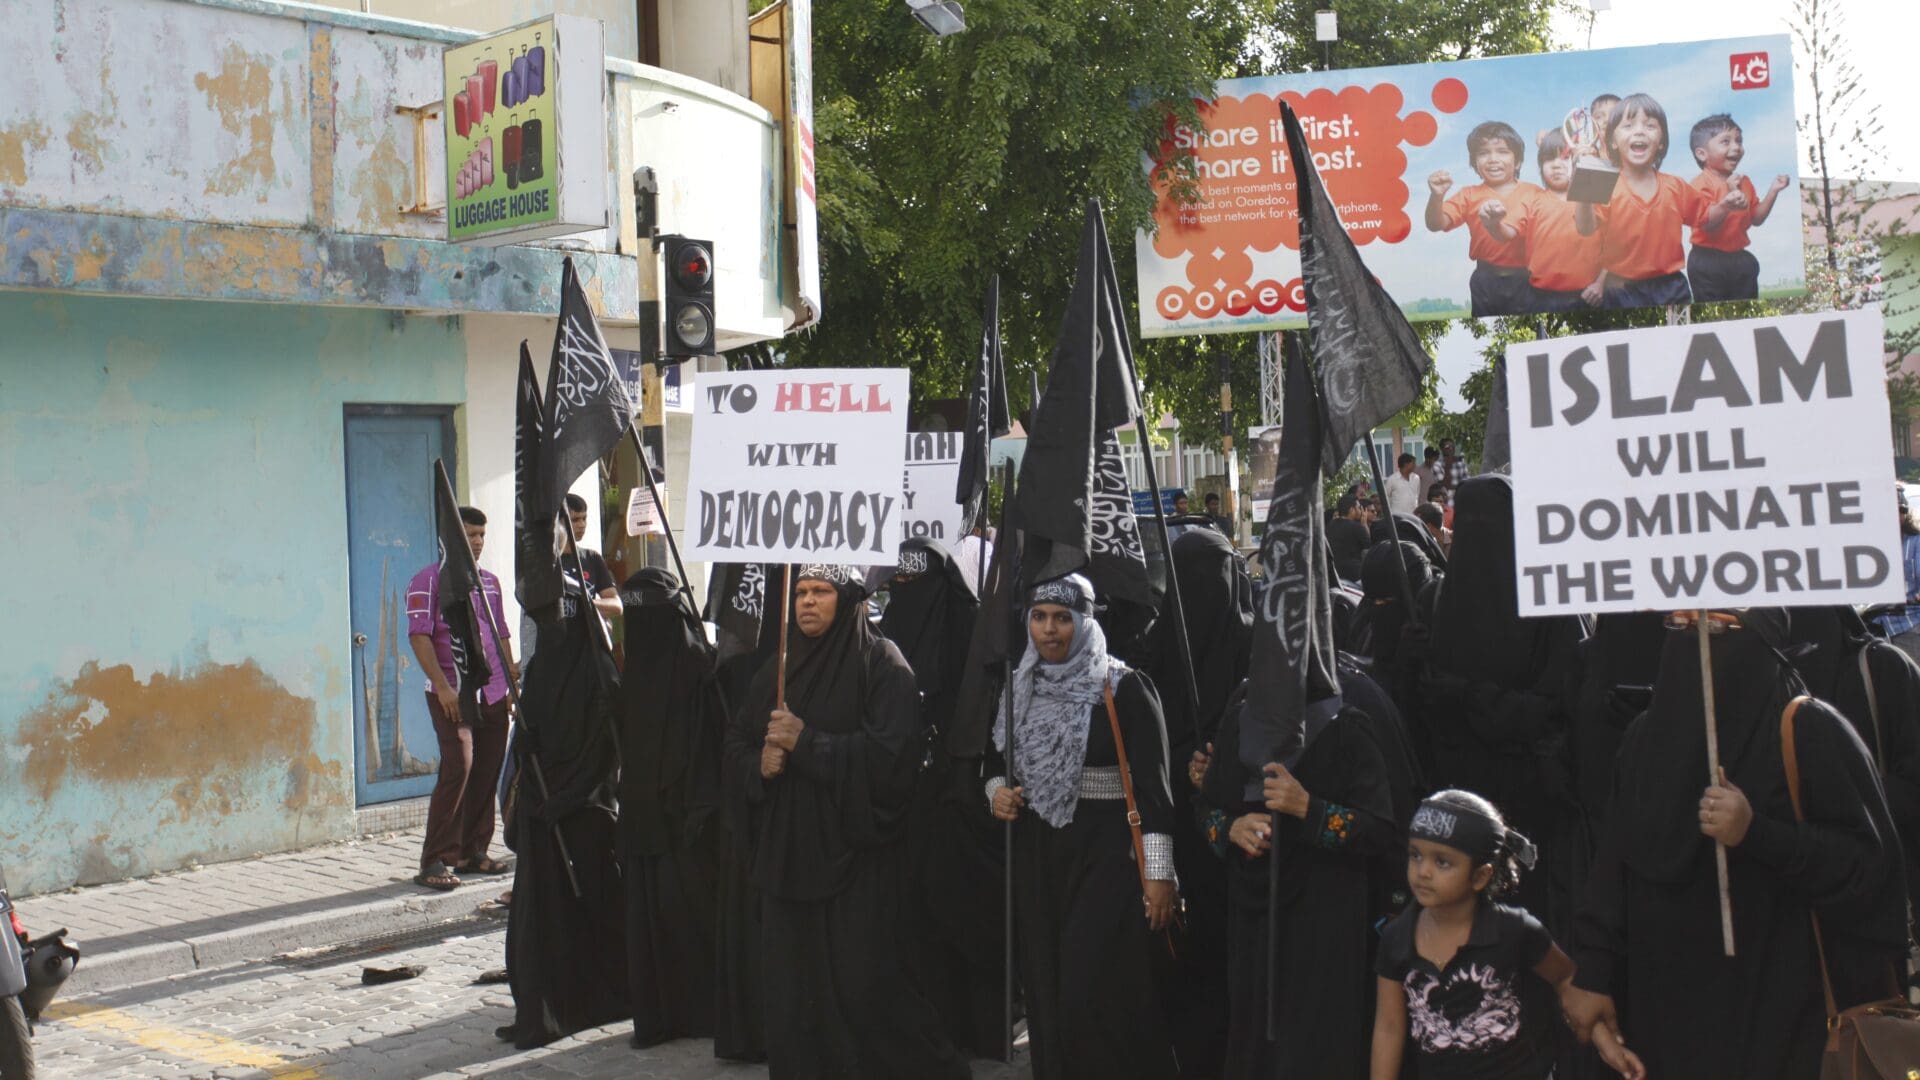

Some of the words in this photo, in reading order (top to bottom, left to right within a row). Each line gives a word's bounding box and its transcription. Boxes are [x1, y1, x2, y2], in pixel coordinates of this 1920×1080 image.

[1733, 56, 1768, 84] 4G
[1174, 125, 1259, 149] Share
[1269, 119, 1284, 143] it
[1299, 113, 1360, 139] first.
[1272, 149, 1288, 174] it
[1309, 144, 1362, 171] ast.
[1208, 185, 1230, 196] best
[1233, 182, 1281, 195] moments
[1285, 182, 1297, 191] ar
[1218, 201, 1232, 209] on
[1236, 195, 1289, 208] Ooredoo,
[456, 198, 507, 229] LUGGAGE
[510, 188, 549, 218] HOUSE
[1179, 214, 1197, 225] the
[1200, 212, 1221, 223] best
[1225, 209, 1265, 221] network
[1269, 207, 1283, 218] for
[1287, 209, 1299, 219] yo
[1164, 285, 1305, 313] oore
[1526, 319, 1853, 428] ISLAM
[707, 384, 757, 414] TO
[774, 382, 892, 413] HELL
[747, 442, 838, 466] WITH
[1617, 428, 1766, 478] WILL
[696, 489, 894, 553] DEMOCRACY
[1537, 481, 1864, 545] DOMINATE
[1523, 559, 1635, 606] THE
[1651, 545, 1890, 599] WORLD
